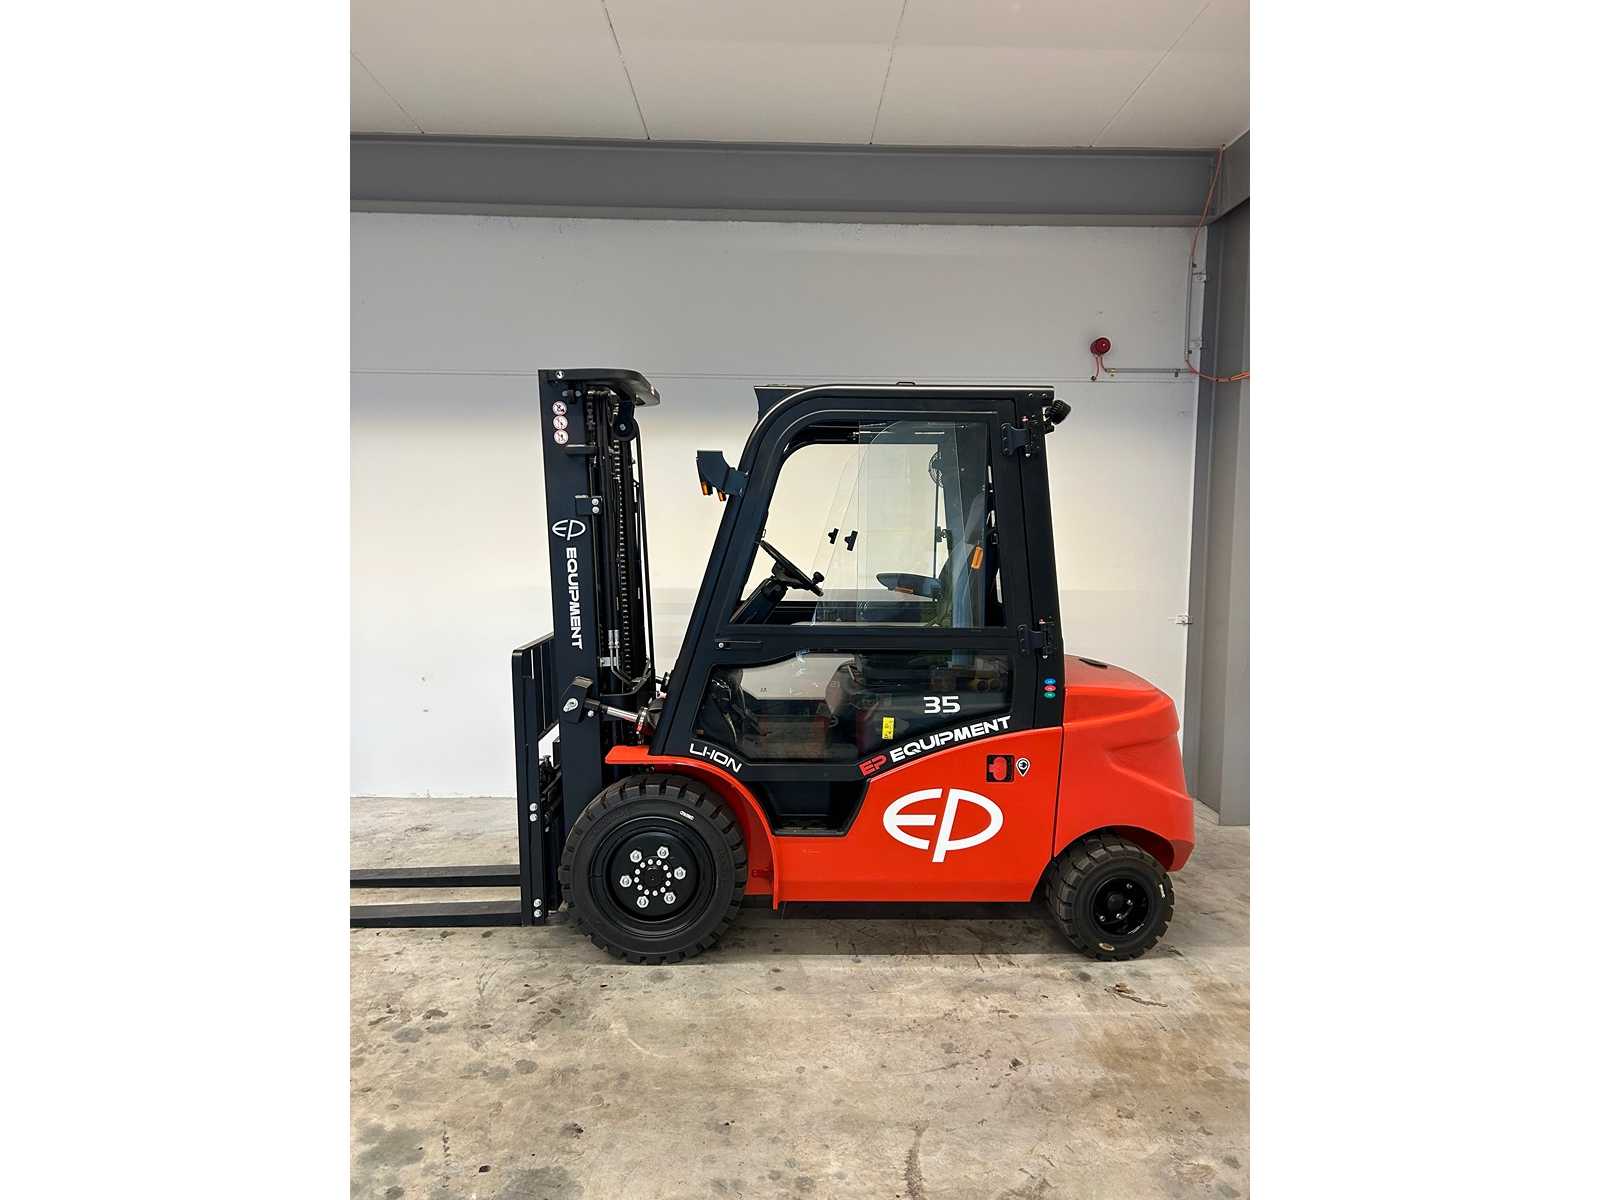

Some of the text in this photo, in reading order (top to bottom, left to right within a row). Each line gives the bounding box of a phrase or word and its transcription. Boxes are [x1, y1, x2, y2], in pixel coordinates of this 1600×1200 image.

[566, 547, 583, 650] EQUIPMENT
[923, 695, 961, 714] 35
[858, 754, 888, 776] EP
[889, 715, 1011, 763] EQUIPMENT
[882, 788, 1004, 862] EP
